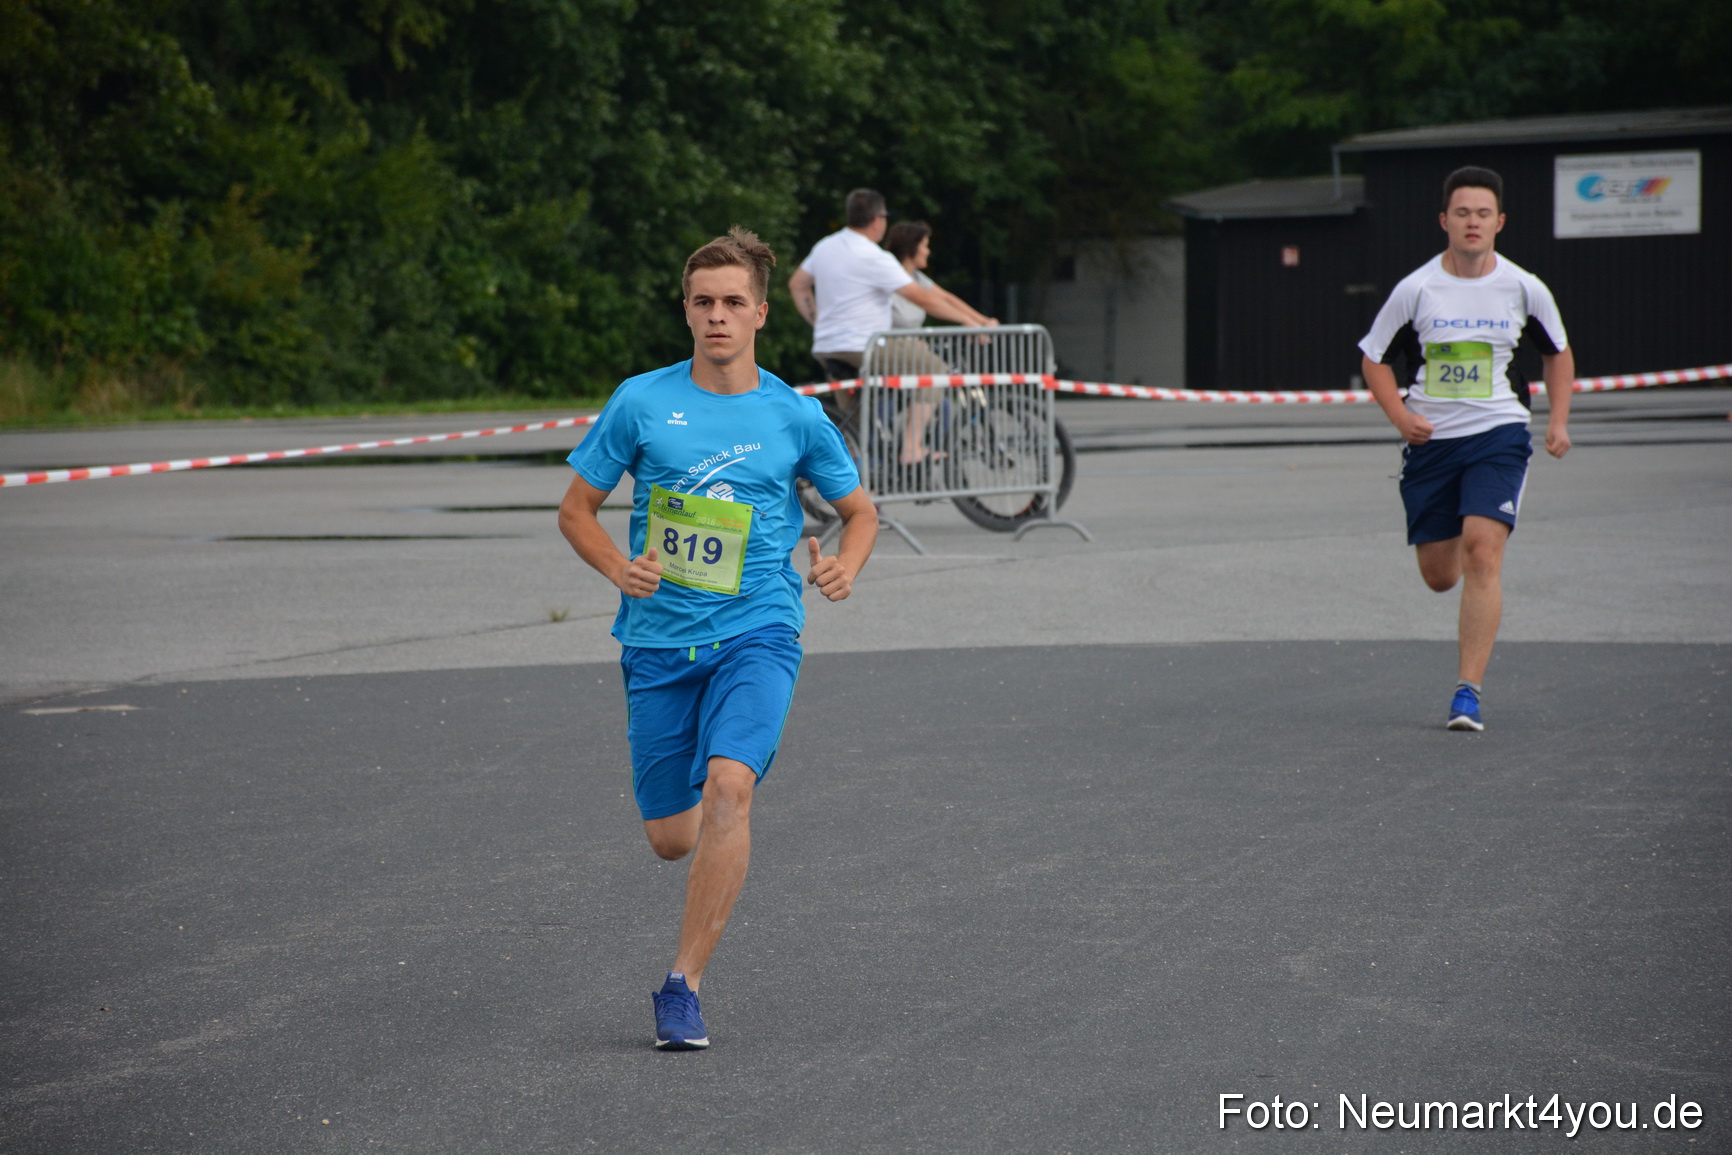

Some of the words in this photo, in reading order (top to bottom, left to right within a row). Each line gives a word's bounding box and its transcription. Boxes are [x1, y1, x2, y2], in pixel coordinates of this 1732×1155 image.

[1432, 319, 1509, 329] DELPHI
[1439, 364, 1480, 384] 294
[669, 476, 689, 493] am
[688, 450, 731, 477] Schick
[733, 442, 761, 455] Bau
[663, 527, 723, 565] 819
[669, 562, 687, 573] Marcel
[688, 568, 708, 577] Krupa
